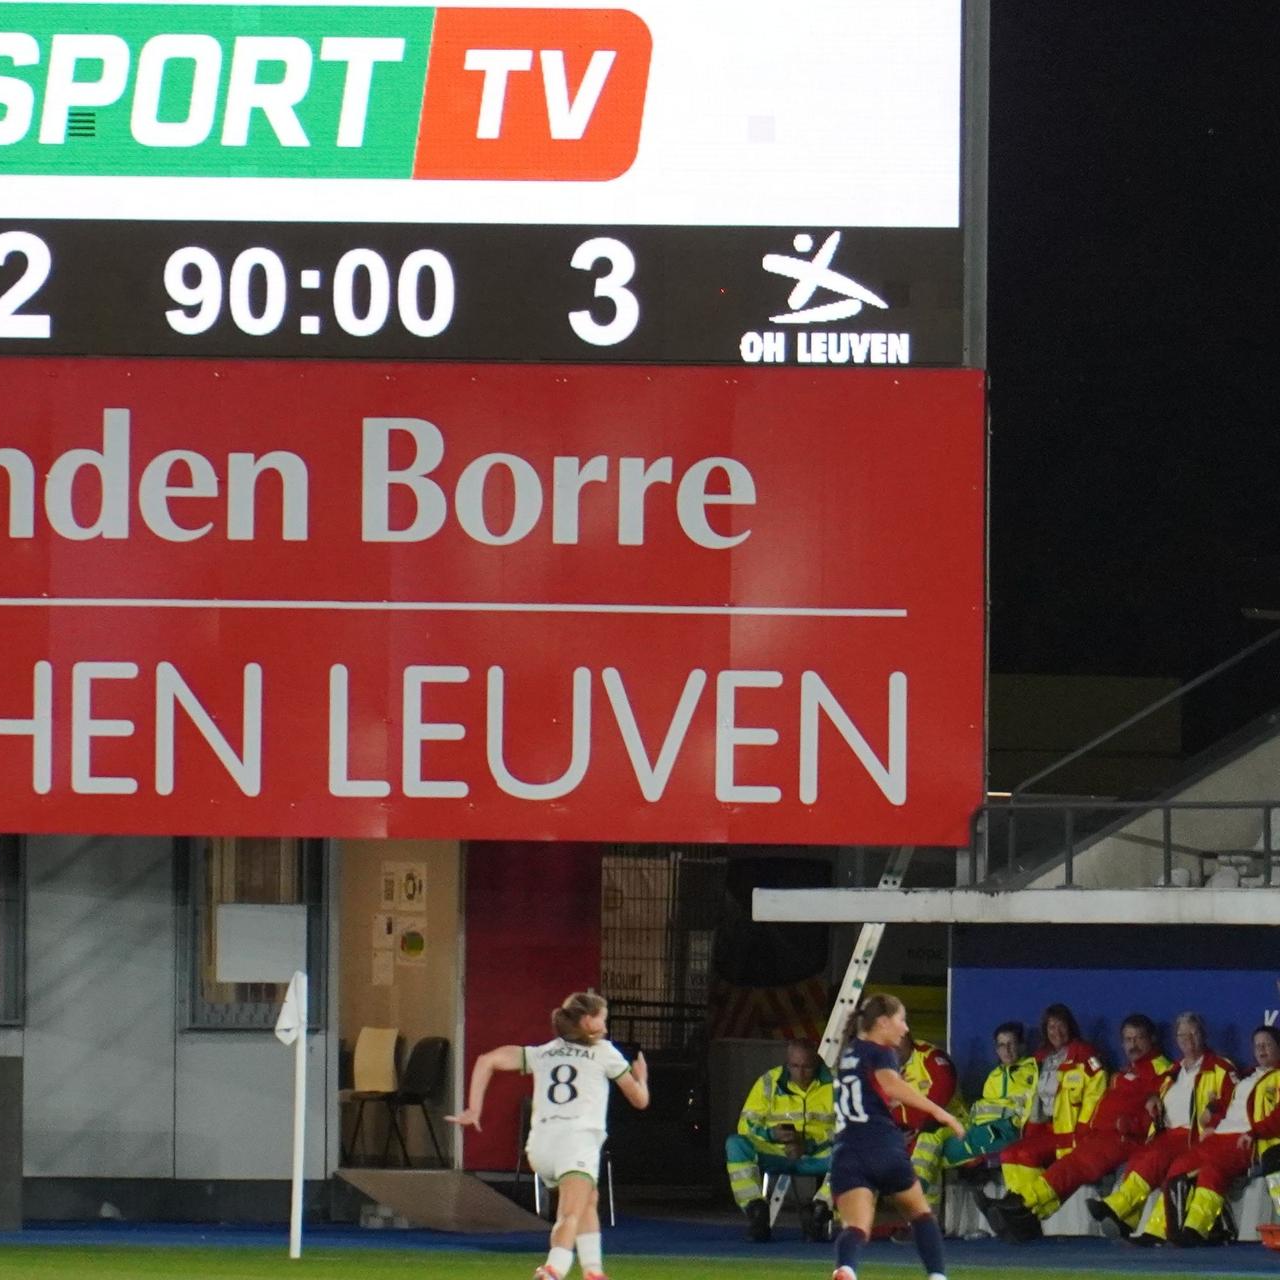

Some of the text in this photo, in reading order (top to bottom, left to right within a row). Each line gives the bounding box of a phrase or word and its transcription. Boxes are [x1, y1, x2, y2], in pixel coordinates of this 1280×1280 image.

[463, 48, 617, 140] TV
[163, 246, 455, 338] 90:00
[568, 236, 640, 346] 3
[739, 331, 910, 364] OH LEUVEN
[360, 416, 757, 551] Borre
[327, 662, 909, 806] LEUVEN
[547, 1064, 579, 1105] 8
